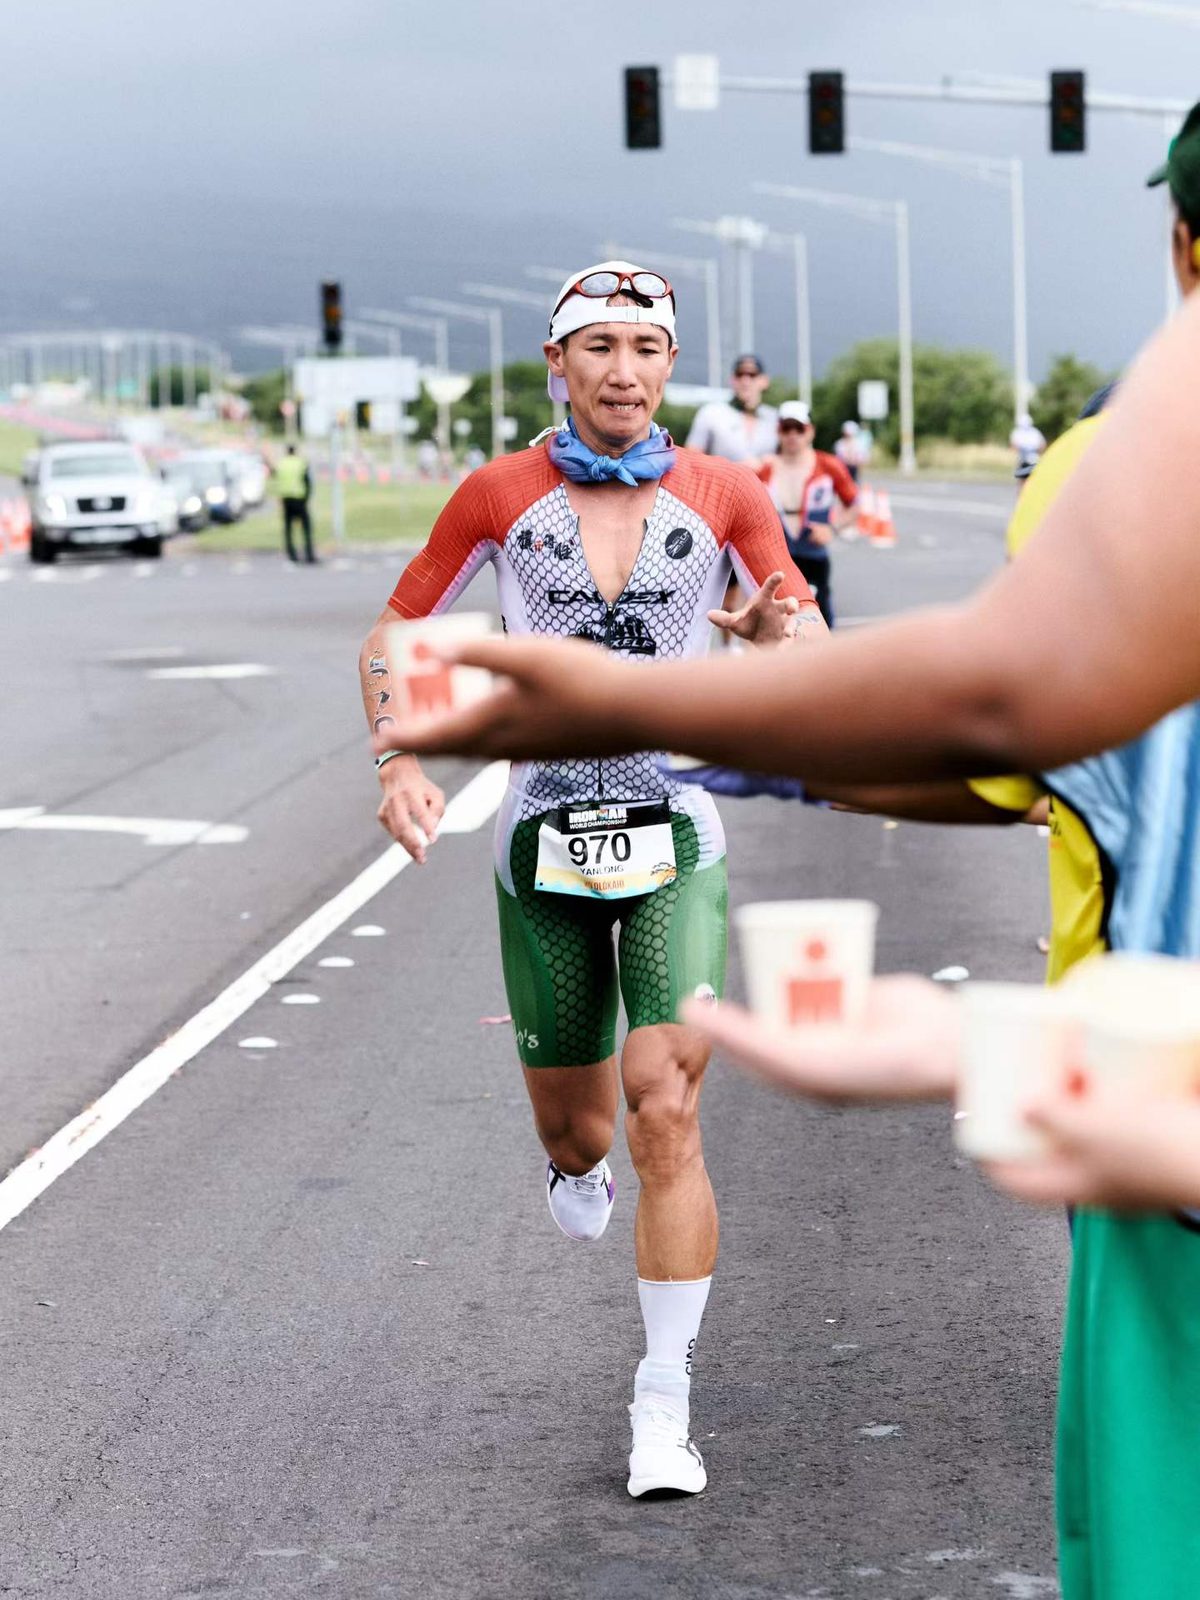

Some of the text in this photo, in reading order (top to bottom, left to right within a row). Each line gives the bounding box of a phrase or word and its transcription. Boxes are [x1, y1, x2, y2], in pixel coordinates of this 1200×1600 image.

[570, 821, 588, 830] WORLD
[587, 818, 628, 828] CHAMPIONSHIP
[568, 832, 631, 866] 970
[580, 864, 625, 876] YANLONG
